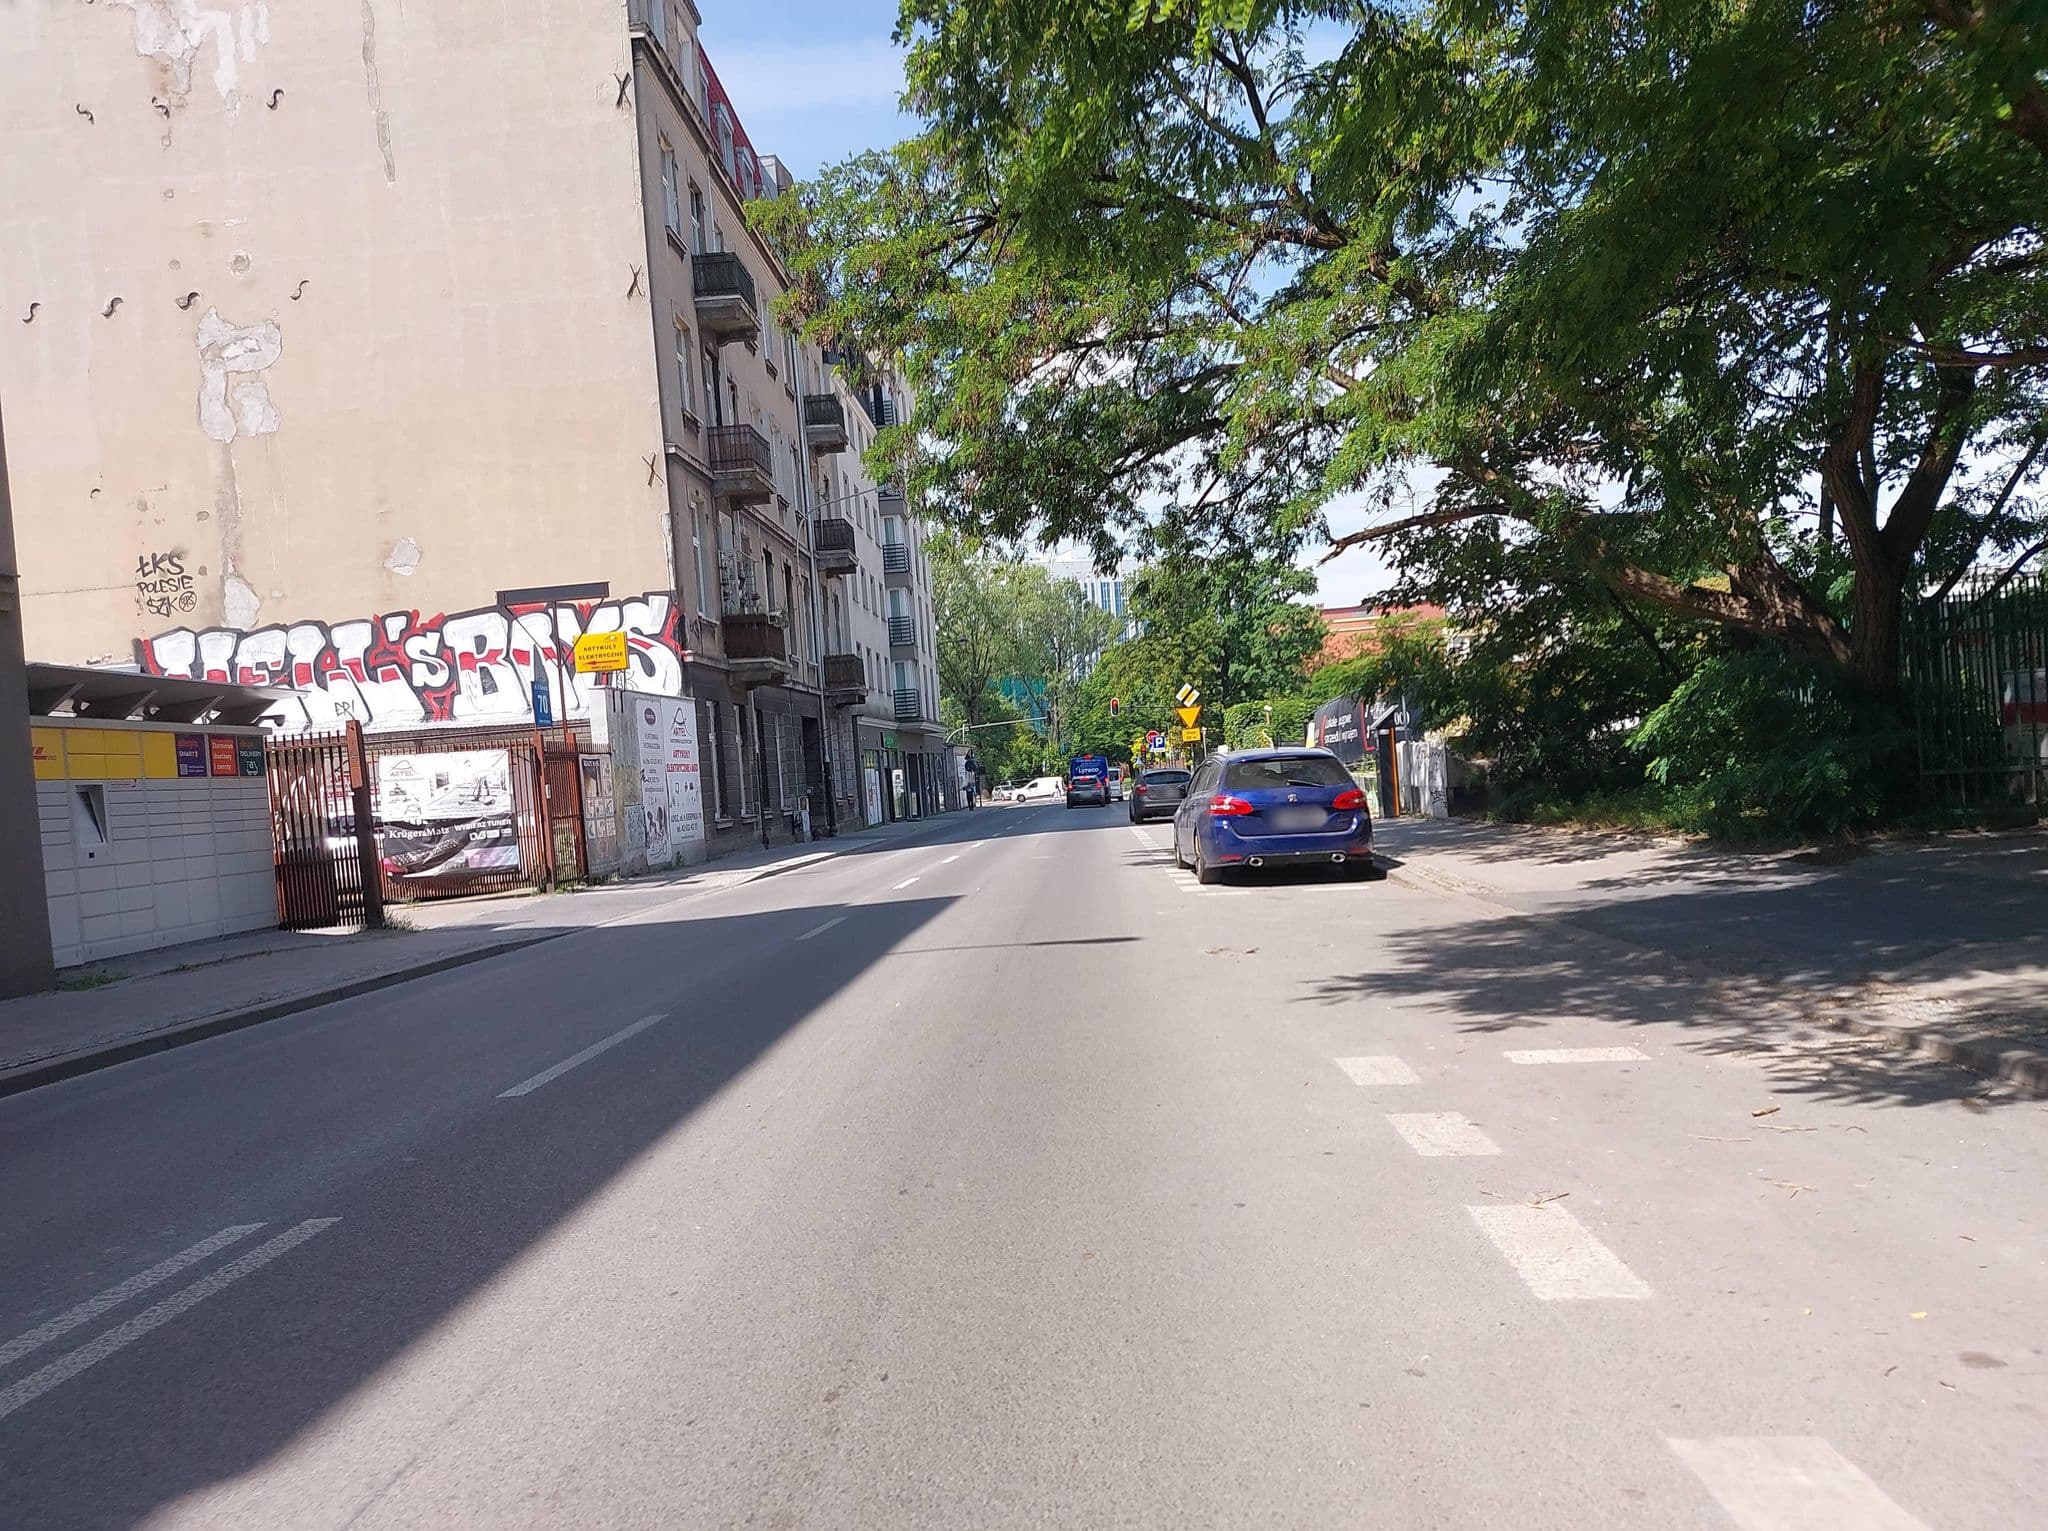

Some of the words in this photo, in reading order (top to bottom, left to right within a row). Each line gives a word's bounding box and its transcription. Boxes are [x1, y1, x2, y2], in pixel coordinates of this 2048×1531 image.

[135, 551, 186, 578] ŁKS
[136, 575, 194, 597] POLESIE
[578, 651, 623, 661] ELEKTRYCZNE
[537, 694, 549, 714] 70
[1155, 738, 1164, 748] P
[239, 750, 262, 758] DELIVERY
[1078, 767, 1100, 775] Lyreco
